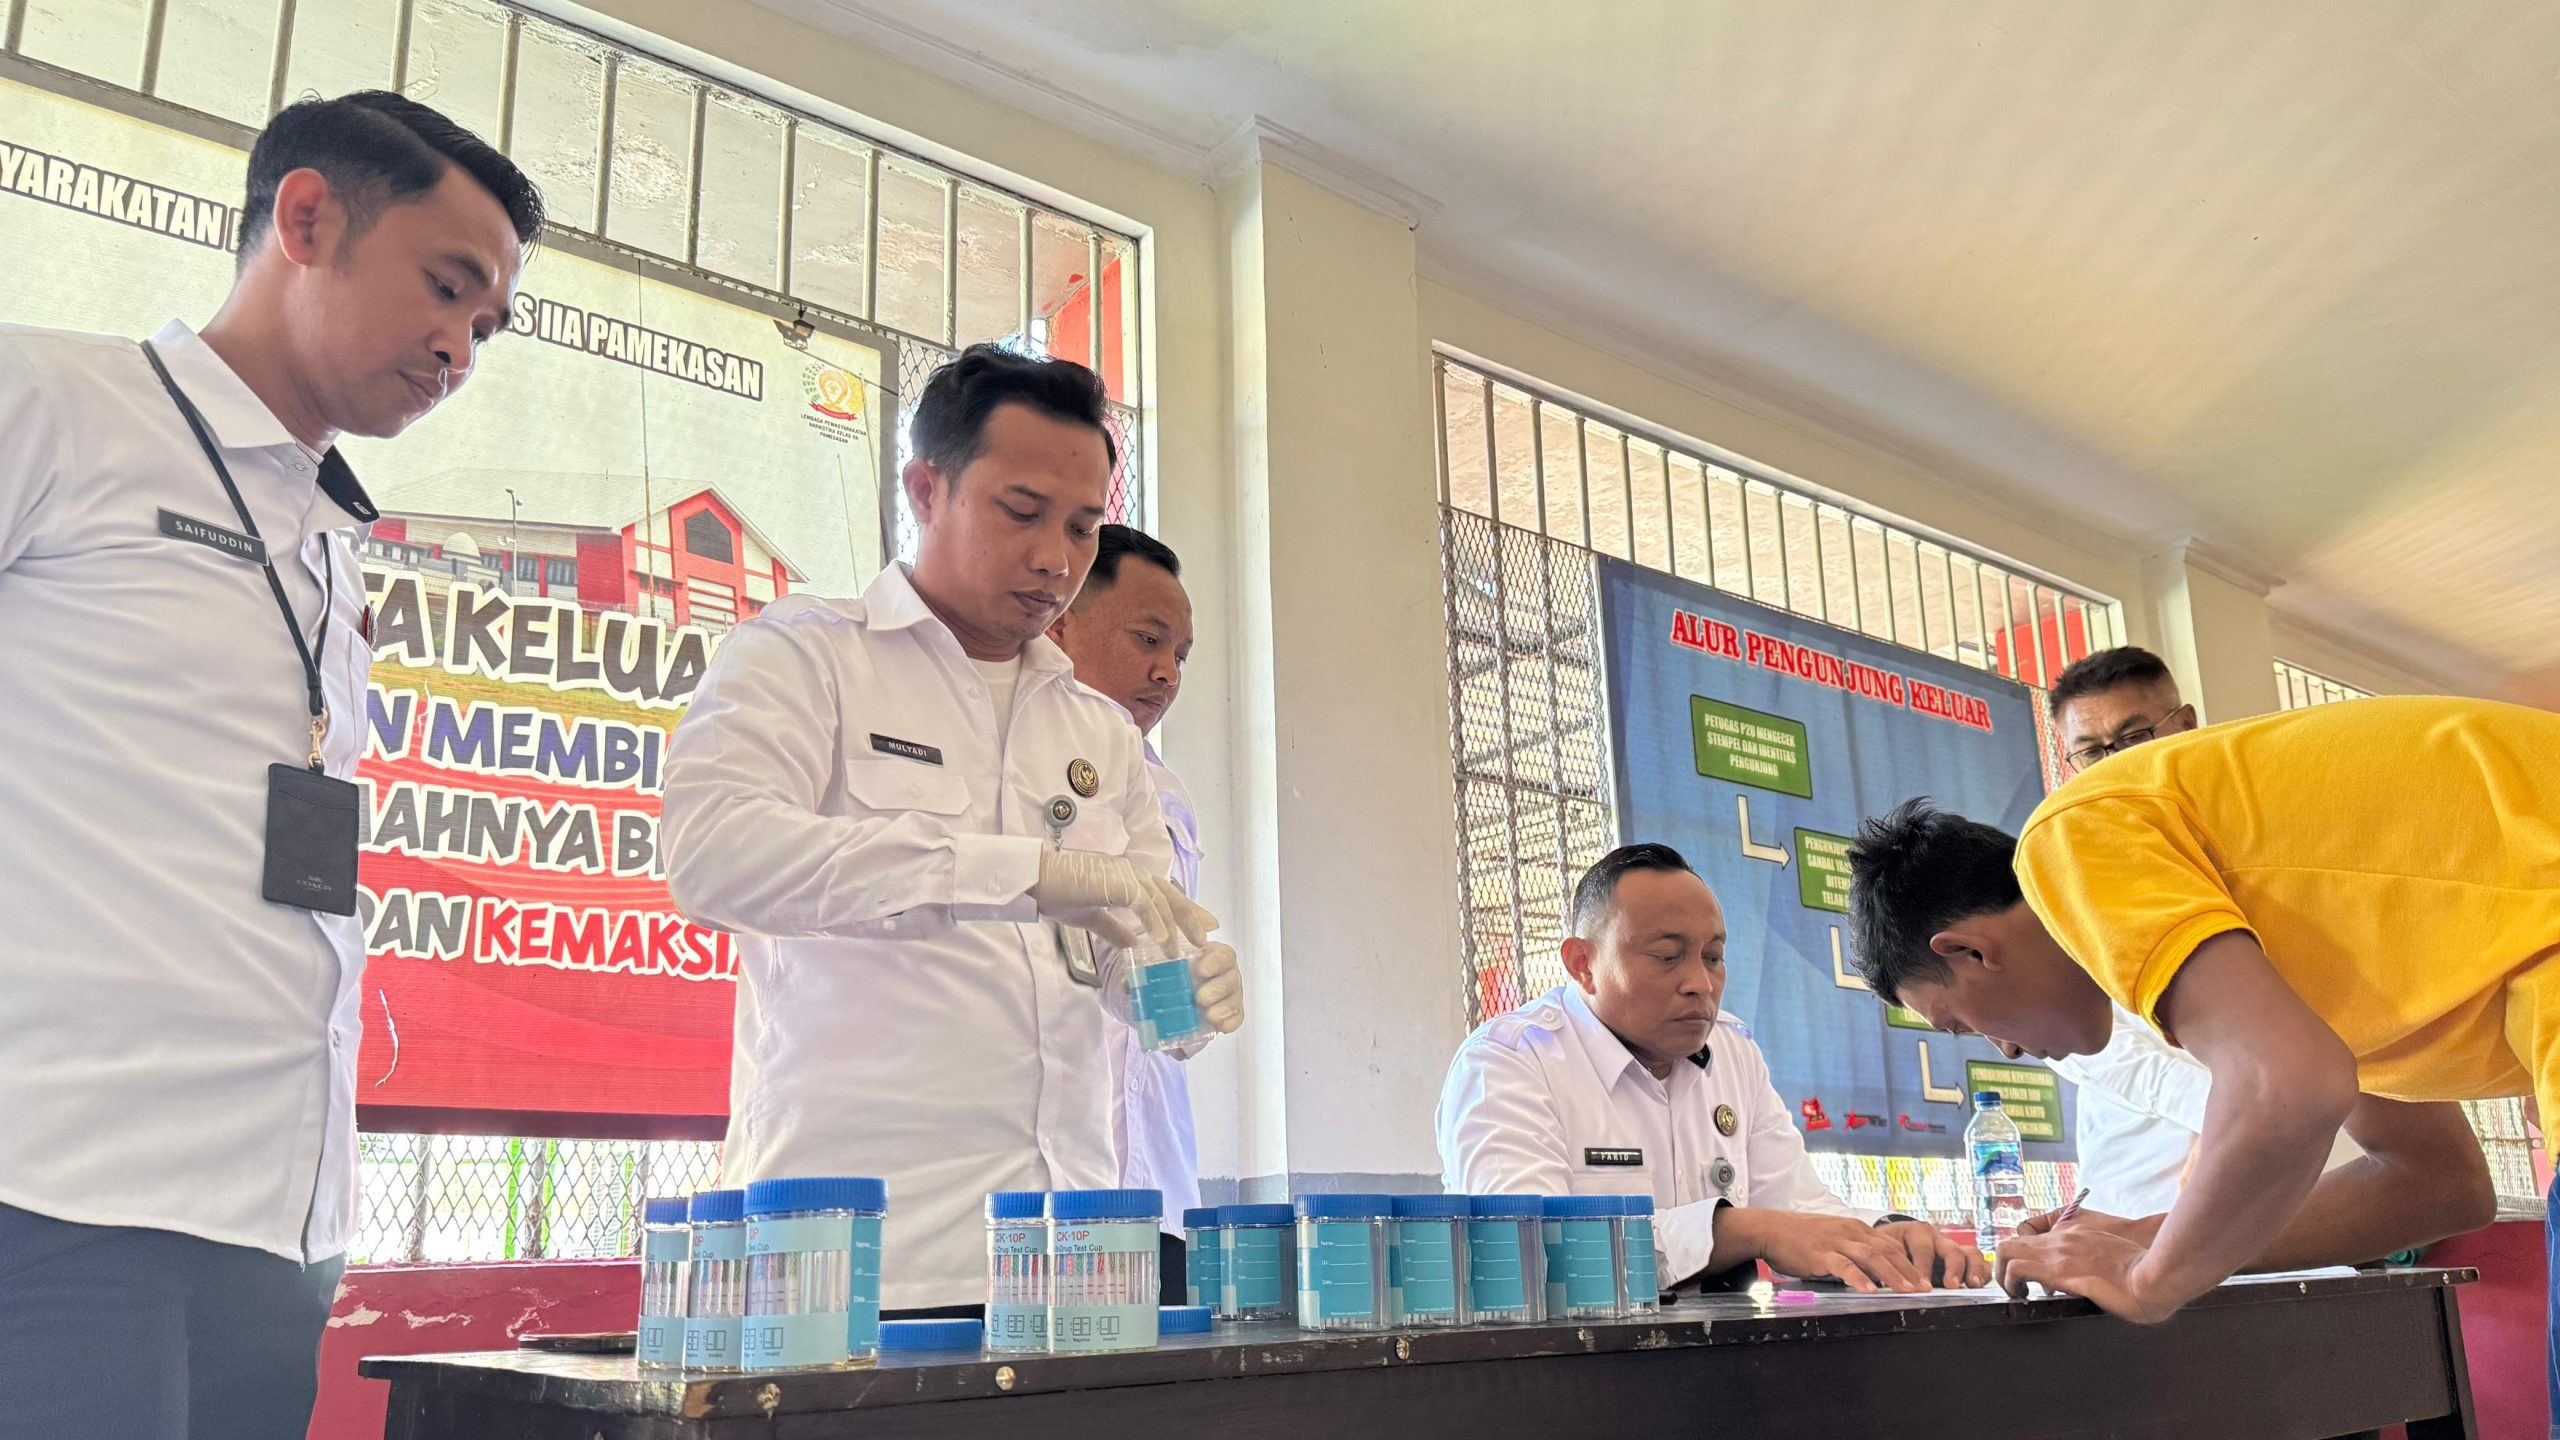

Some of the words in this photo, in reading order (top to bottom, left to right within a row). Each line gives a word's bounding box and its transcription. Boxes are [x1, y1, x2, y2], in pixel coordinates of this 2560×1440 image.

[0, 141, 225, 249] YARAKATAN
[504, 292, 537, 337] S
[537, 299, 584, 351] IIA
[587, 312, 763, 401] PAMEKASAN
[175, 520, 253, 553] SAIFUDDIN
[452, 590, 709, 702] KELUA
[1671, 609, 1742, 661] ALUR
[1744, 629, 1905, 708] PENGUNJUNG
[1908, 677, 1993, 733] KELUAR
[366, 689, 412, 755] N
[428, 702, 666, 791] MEMBI
[888, 741, 927, 757] MULYADI
[1704, 713, 1740, 734] PETUGAS
[1756, 726, 1796, 748] MENGECEK
[1706, 731, 1741, 751] STEMPEL
[1742, 739, 1758, 755] DAN
[1758, 743, 1797, 764] IDENTITAS
[480, 903, 740, 976] KEMAKSI
[1024, 1246, 1039, 1254] Cup
[1074, 1244, 1087, 1252] Test
[1088, 1243, 1103, 1252] Cup
